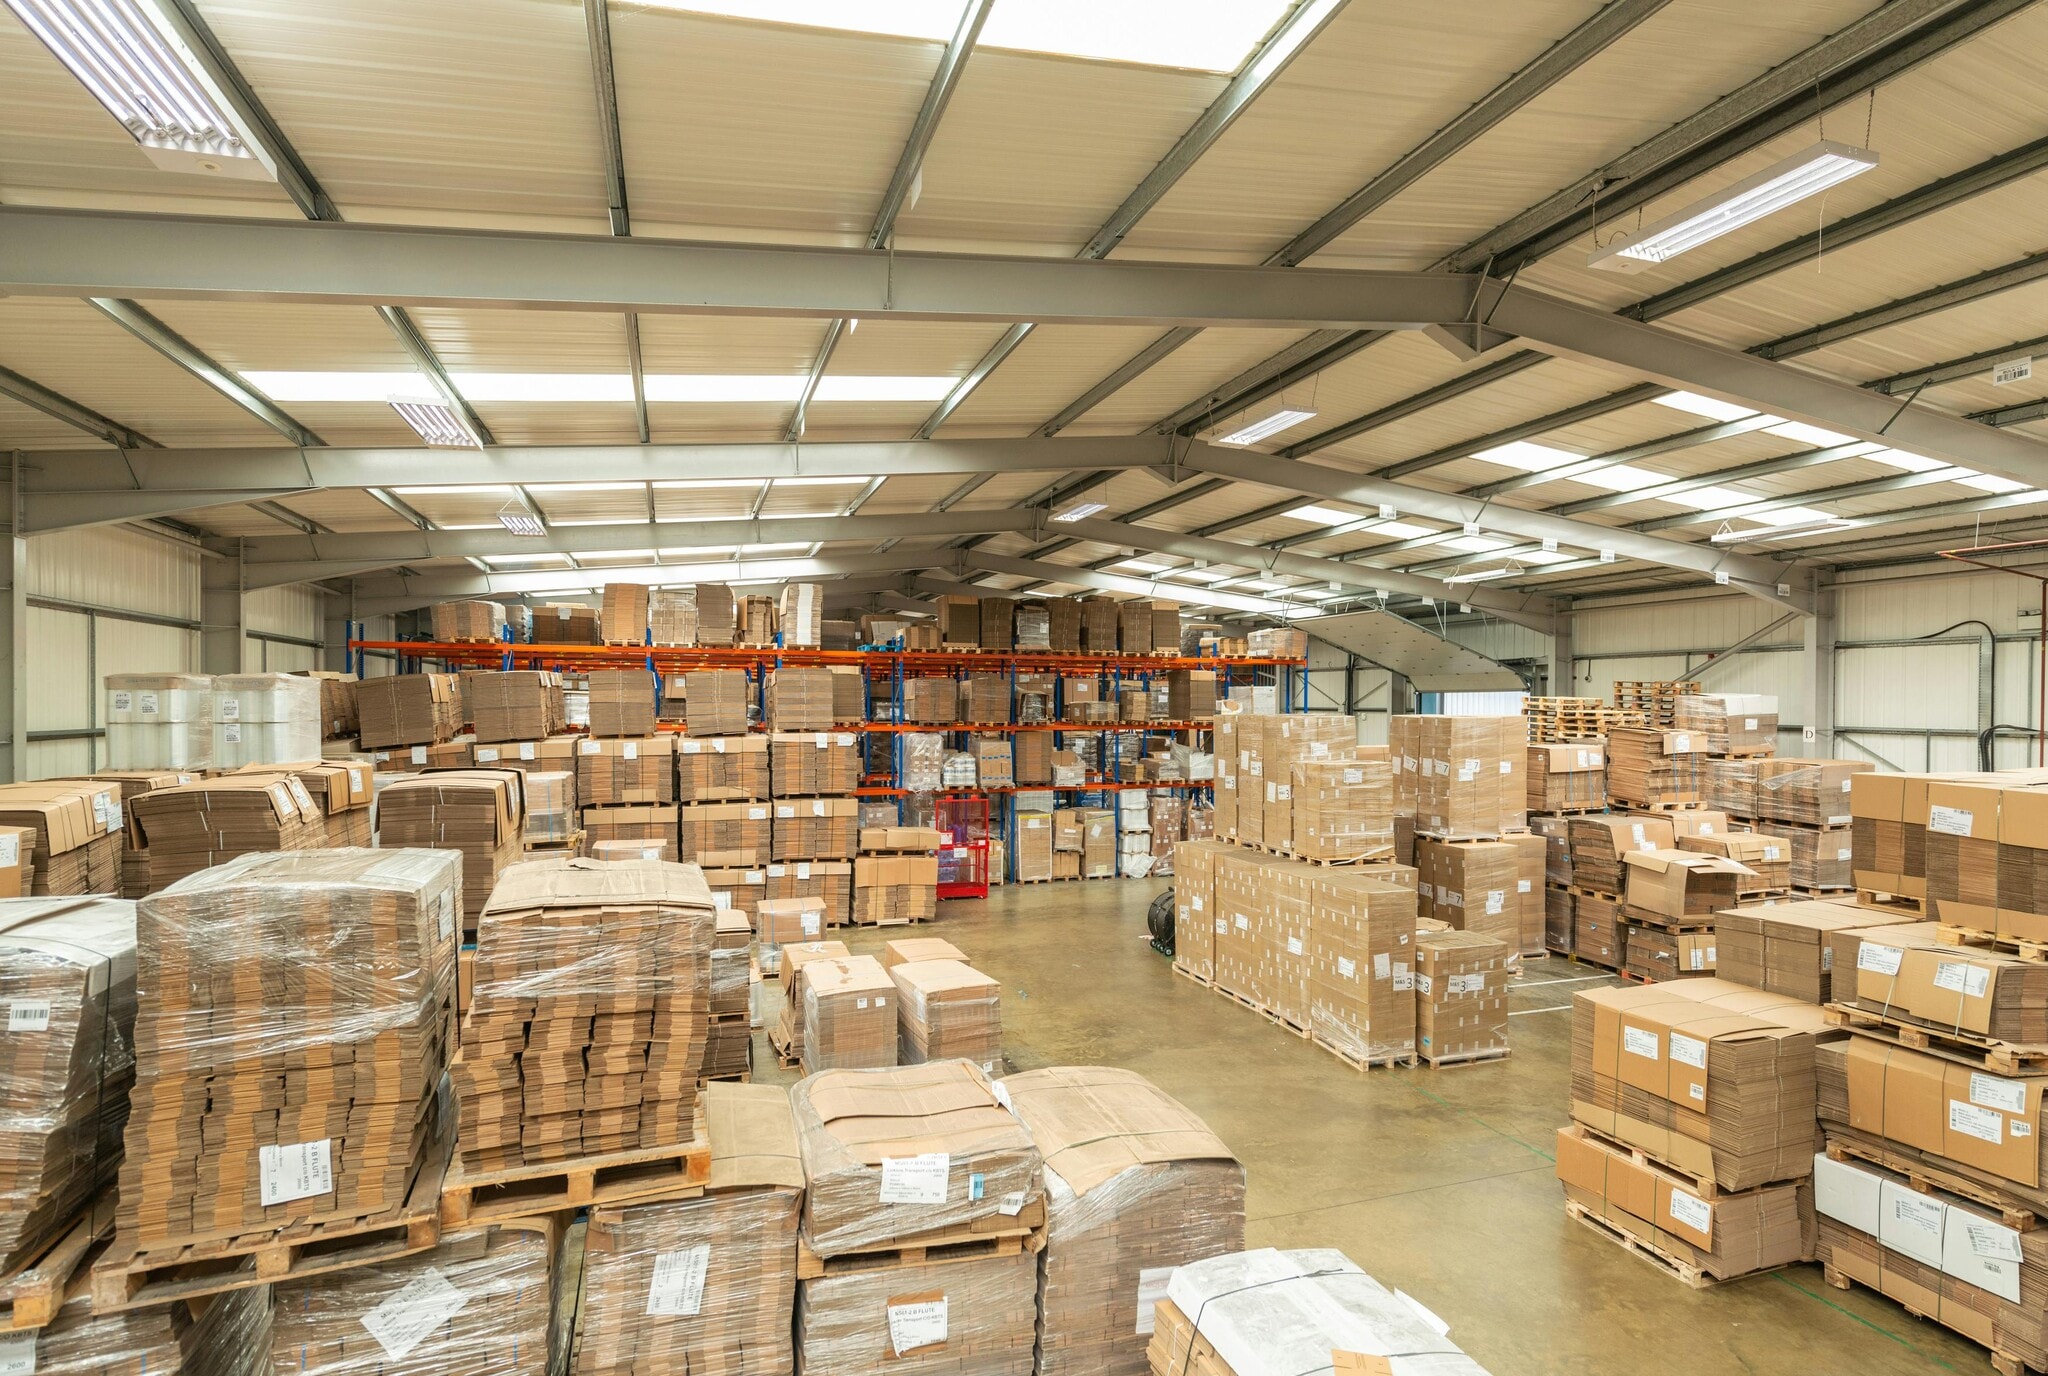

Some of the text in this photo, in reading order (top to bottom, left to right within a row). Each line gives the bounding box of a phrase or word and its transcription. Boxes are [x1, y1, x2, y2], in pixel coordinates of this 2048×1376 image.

[1805, 730, 1813, 739] D
[1443, 764, 1448, 773] 7
[1473, 761, 1479, 770] 7
[1456, 895, 1461, 904] 7
[1406, 977, 1413, 989] 3
[1423, 981, 1430, 993] 3
[1460, 980, 1466, 992] 3
[311, 1157, 319, 1179] FLUTE
[8, 1361, 26, 1370] 2600
